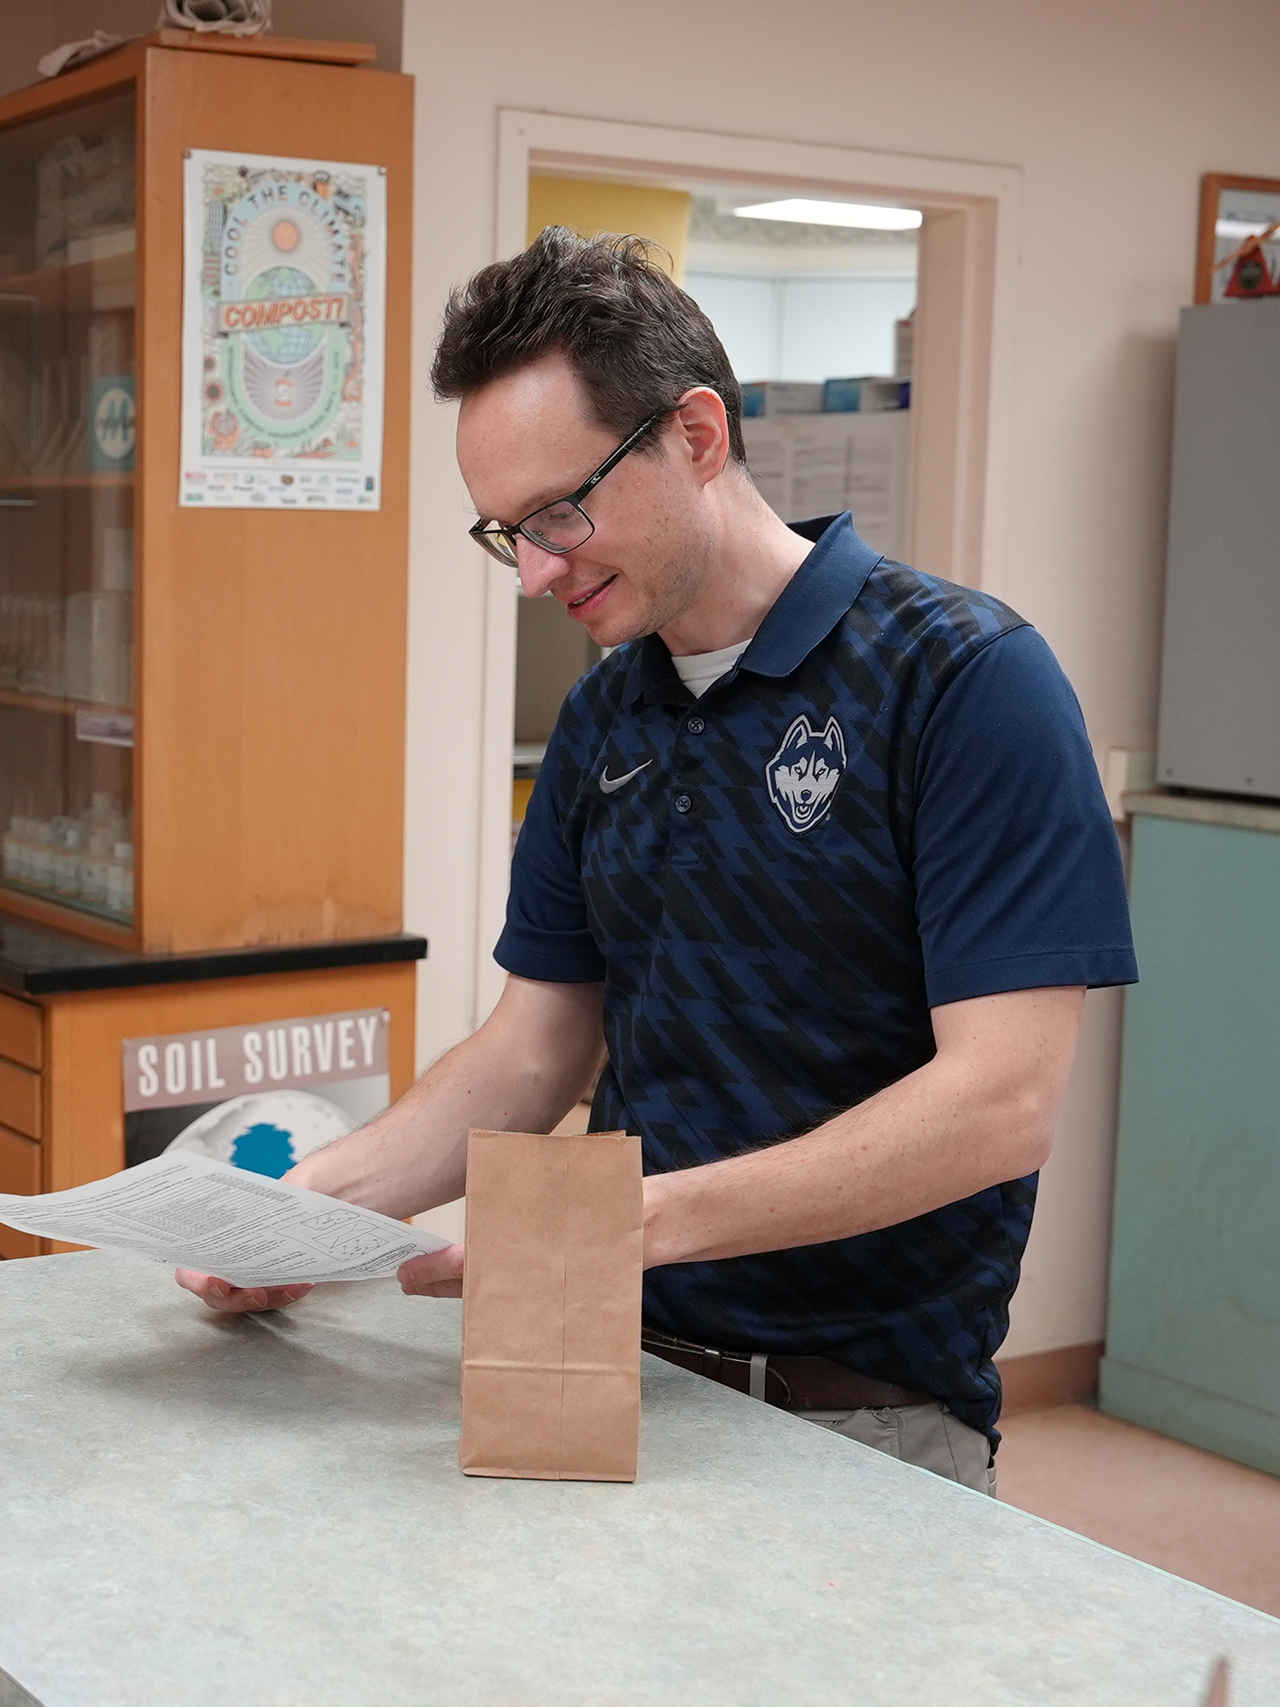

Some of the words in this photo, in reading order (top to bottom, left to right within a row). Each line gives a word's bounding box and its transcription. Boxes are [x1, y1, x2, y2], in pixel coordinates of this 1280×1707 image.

[224, 217, 248, 276] COOL
[247, 185, 288, 210] THE
[298, 190, 347, 282] CLIMATE
[137, 1037, 226, 1097] SOIL
[242, 1014, 378, 1084] SURVEY
